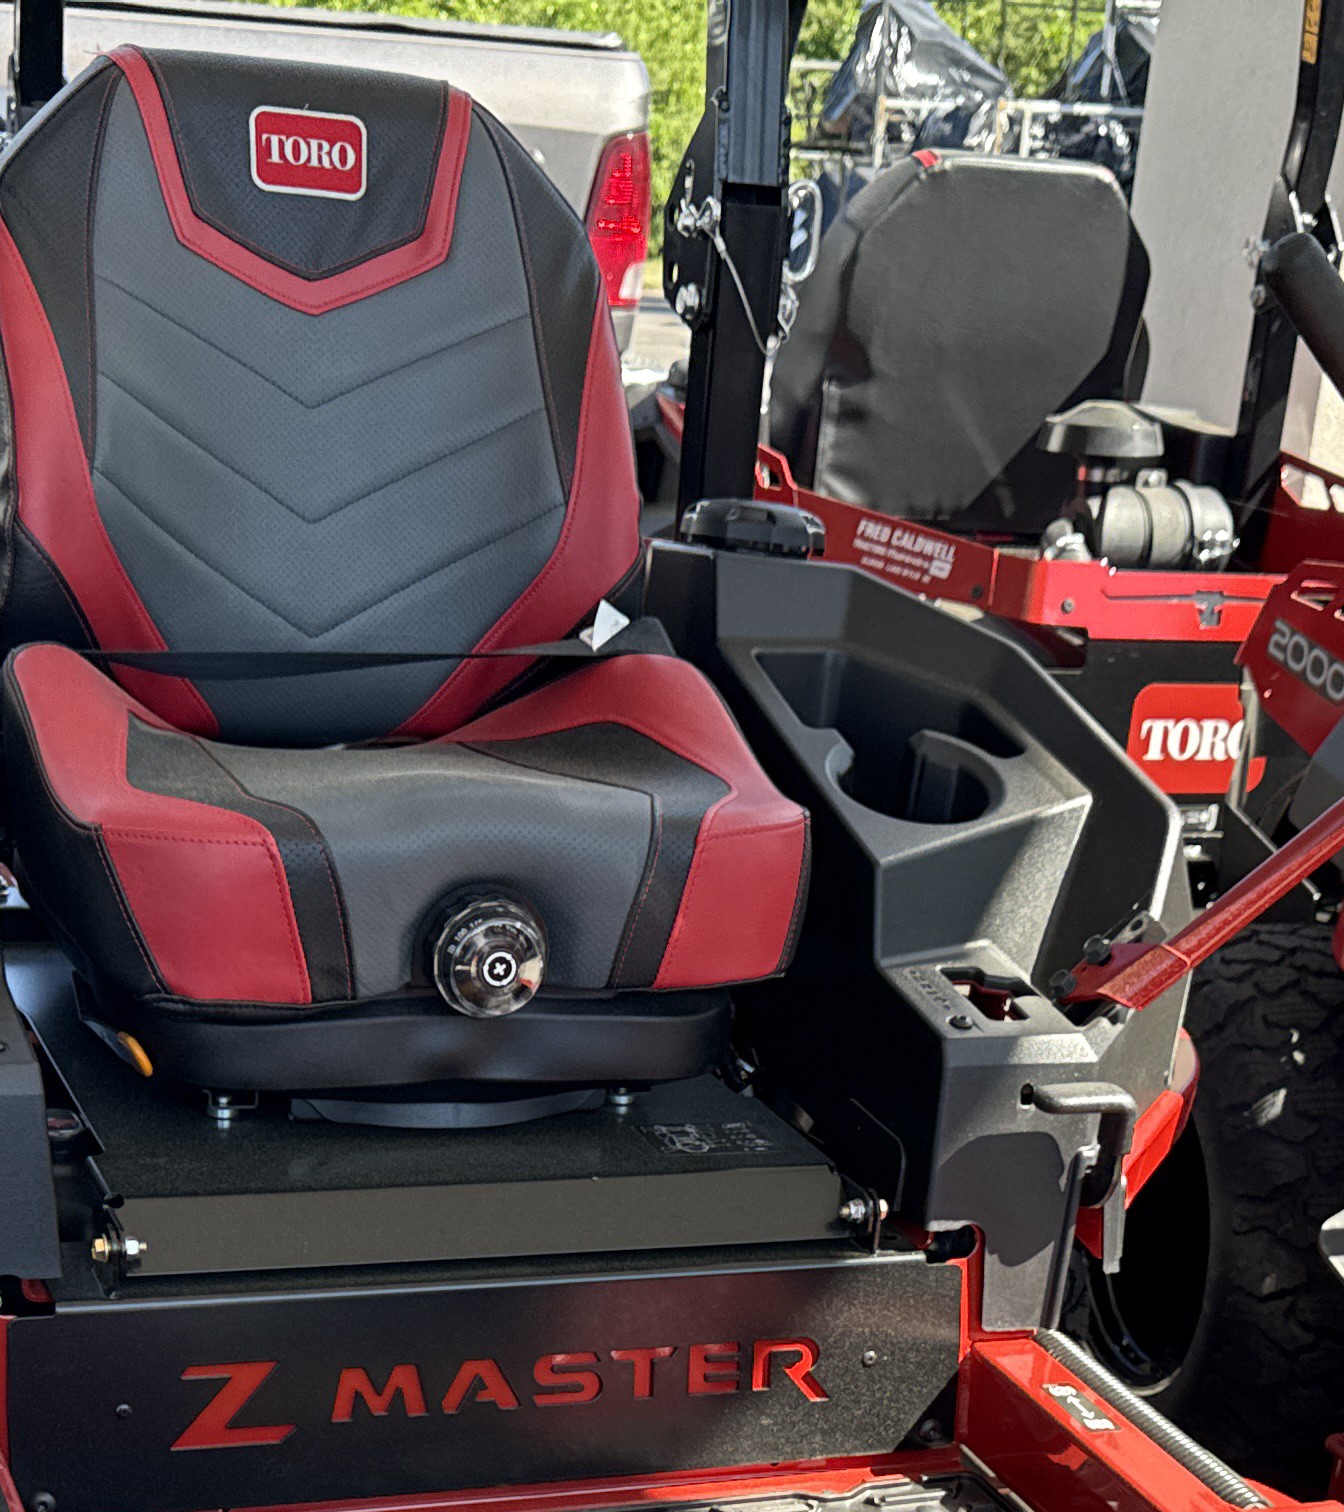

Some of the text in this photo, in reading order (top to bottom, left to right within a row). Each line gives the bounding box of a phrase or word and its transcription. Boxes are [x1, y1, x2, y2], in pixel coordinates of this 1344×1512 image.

[261, 132, 356, 171] TORO
[856, 518, 892, 543] FRED
[890, 527, 956, 561] CALDWELL
[169, 1336, 831, 1453] Z MASTER
